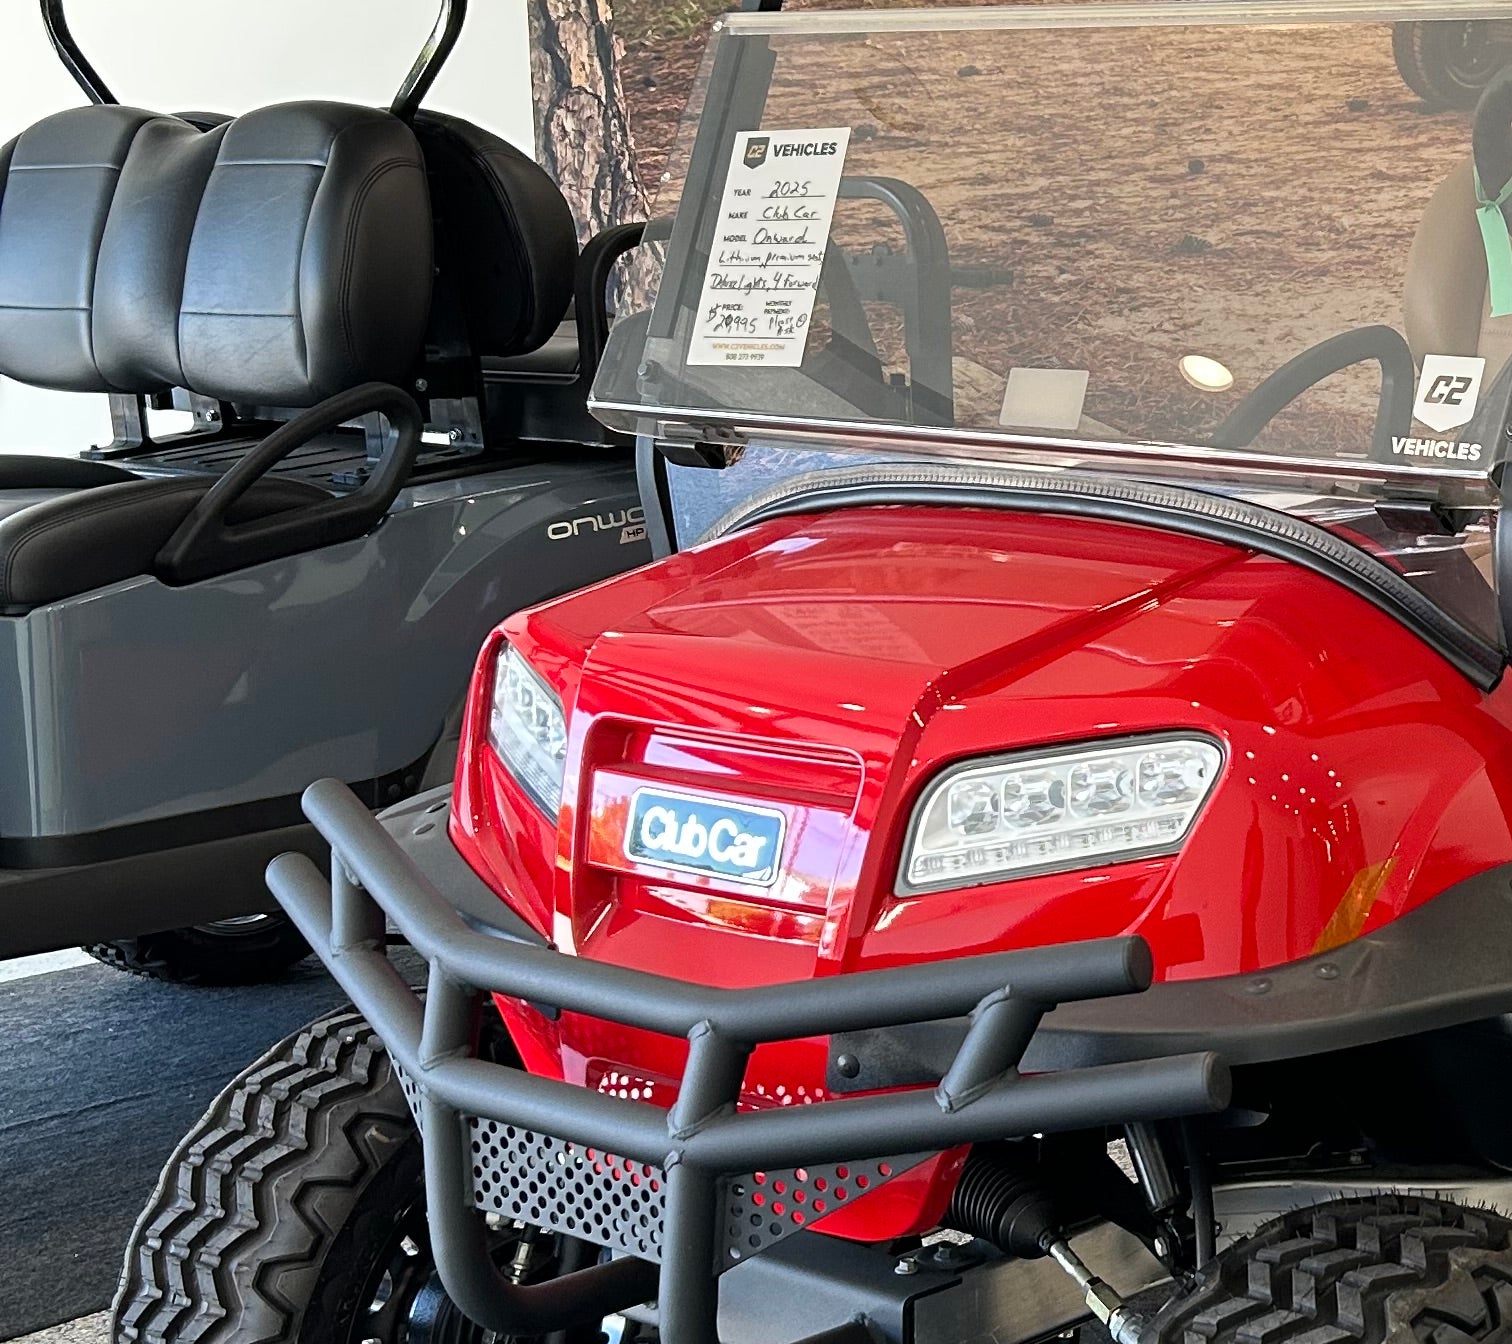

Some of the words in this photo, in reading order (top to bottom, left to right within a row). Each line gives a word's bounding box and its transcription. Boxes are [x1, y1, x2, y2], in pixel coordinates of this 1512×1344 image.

[747, 144, 766, 159] C2
[773, 142, 839, 157] VEHICLES
[769, 181, 811, 198] 2025
[794, 206, 818, 218] Car
[1424, 375, 1473, 405] C2
[1391, 436, 1482, 461] VEHICLES
